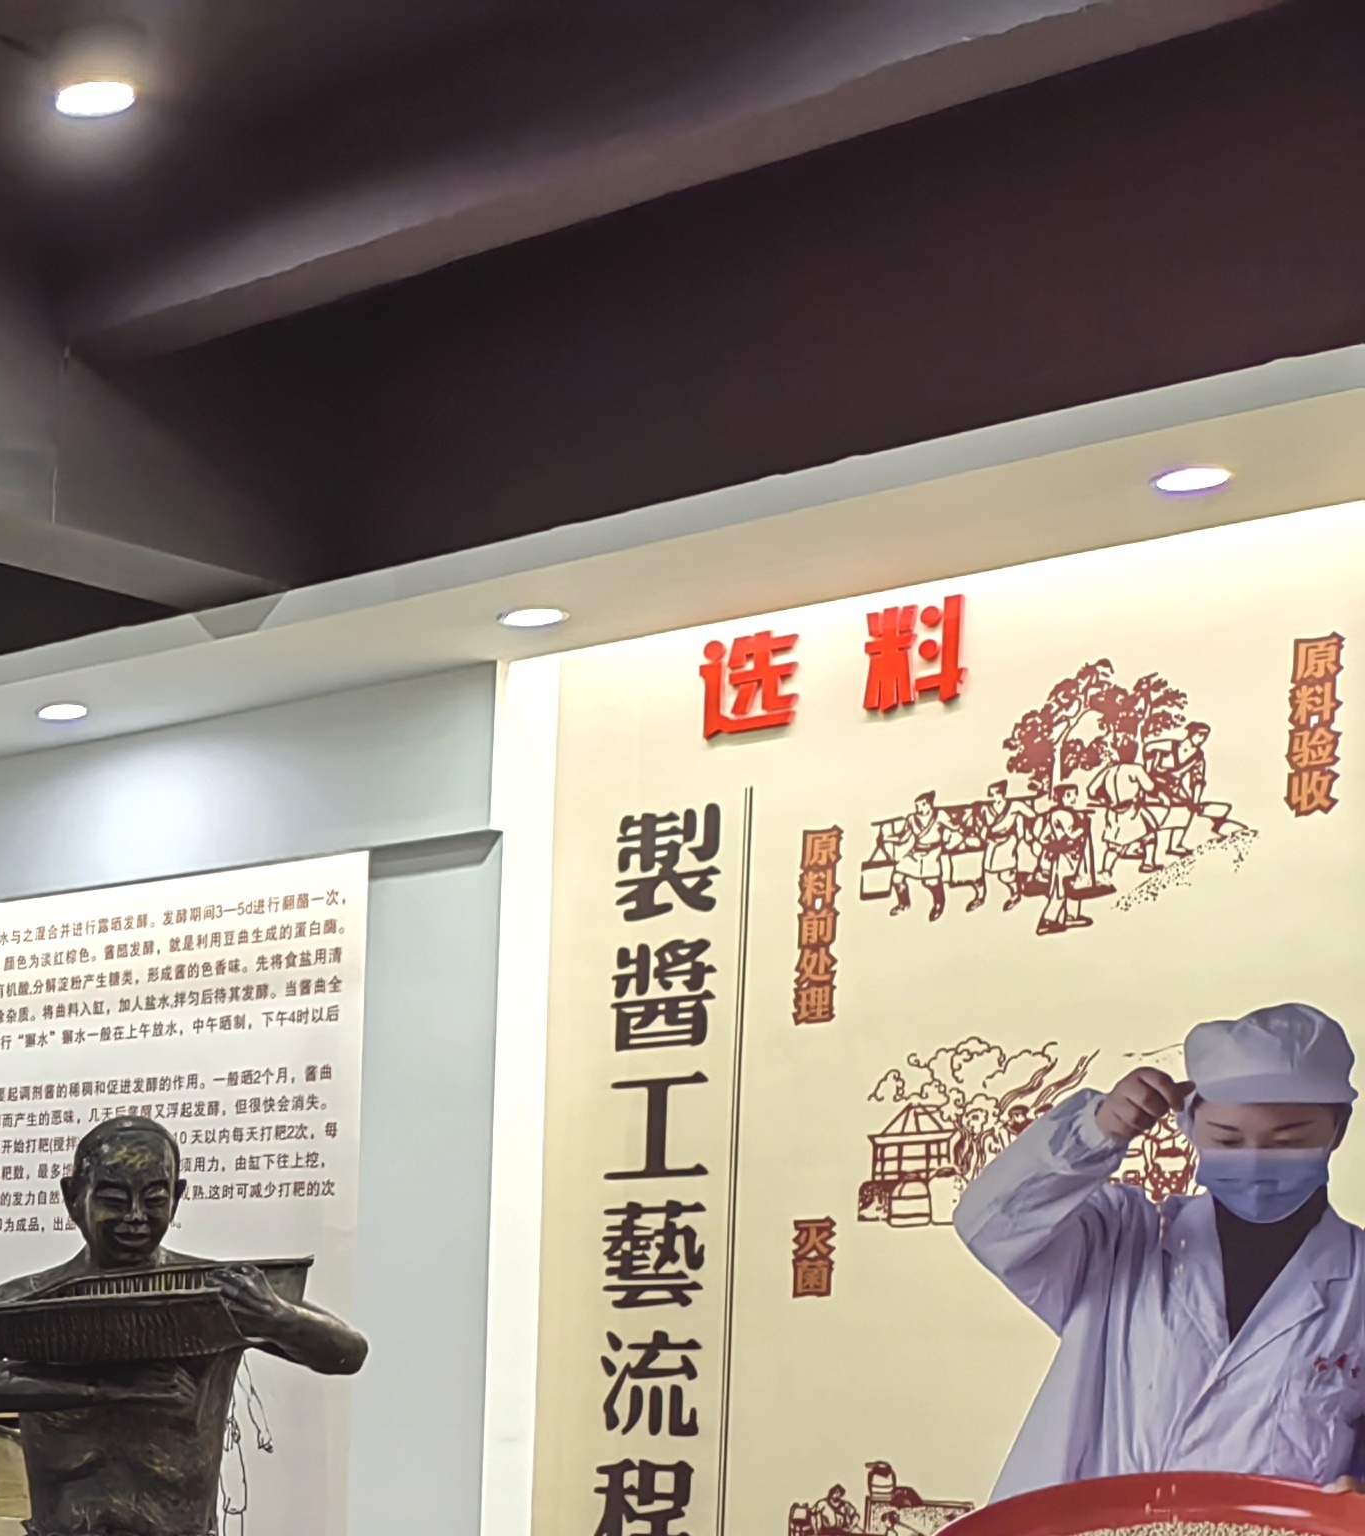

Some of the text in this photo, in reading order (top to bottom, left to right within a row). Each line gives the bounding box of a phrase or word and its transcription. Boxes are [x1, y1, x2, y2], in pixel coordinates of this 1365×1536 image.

[700, 593, 967, 739] 选料
[1286, 631, 1344, 817] 原料验收
[793, 825, 844, 1026] 原料前处理
[792, 1215, 837, 1298] 灭菌
